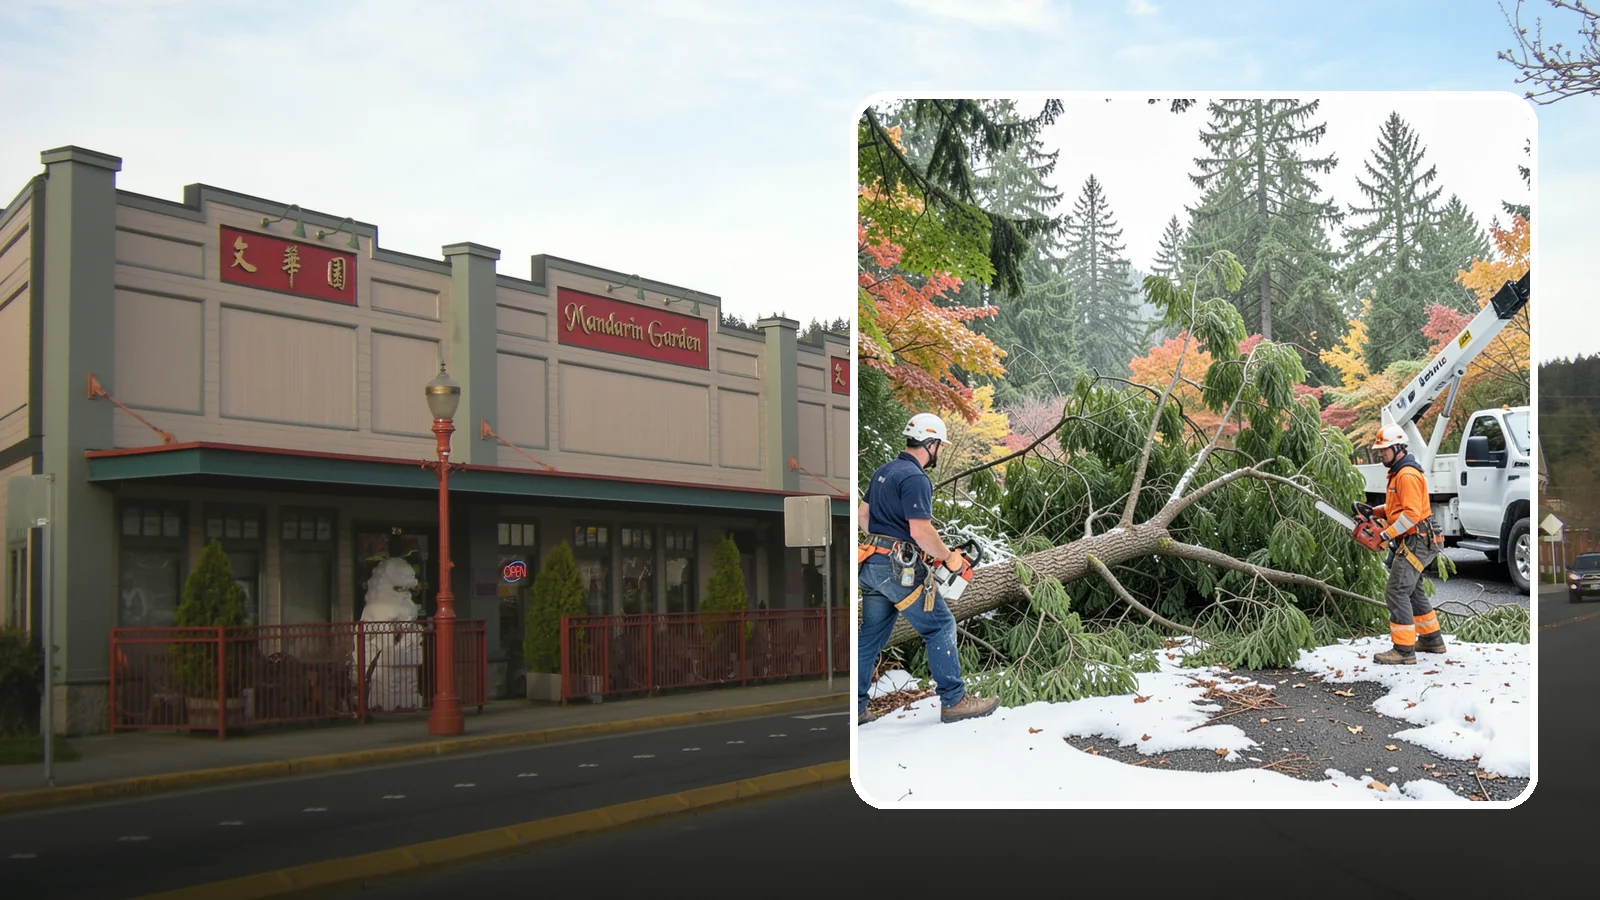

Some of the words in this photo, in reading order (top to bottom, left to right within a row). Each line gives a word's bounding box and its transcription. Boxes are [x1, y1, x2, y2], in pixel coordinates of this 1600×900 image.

[230, 235, 346, 291] 文華園
[564, 302, 644, 341] Mandarin
[648, 320, 702, 352] Garden
[503, 565, 527, 578] OPEN
